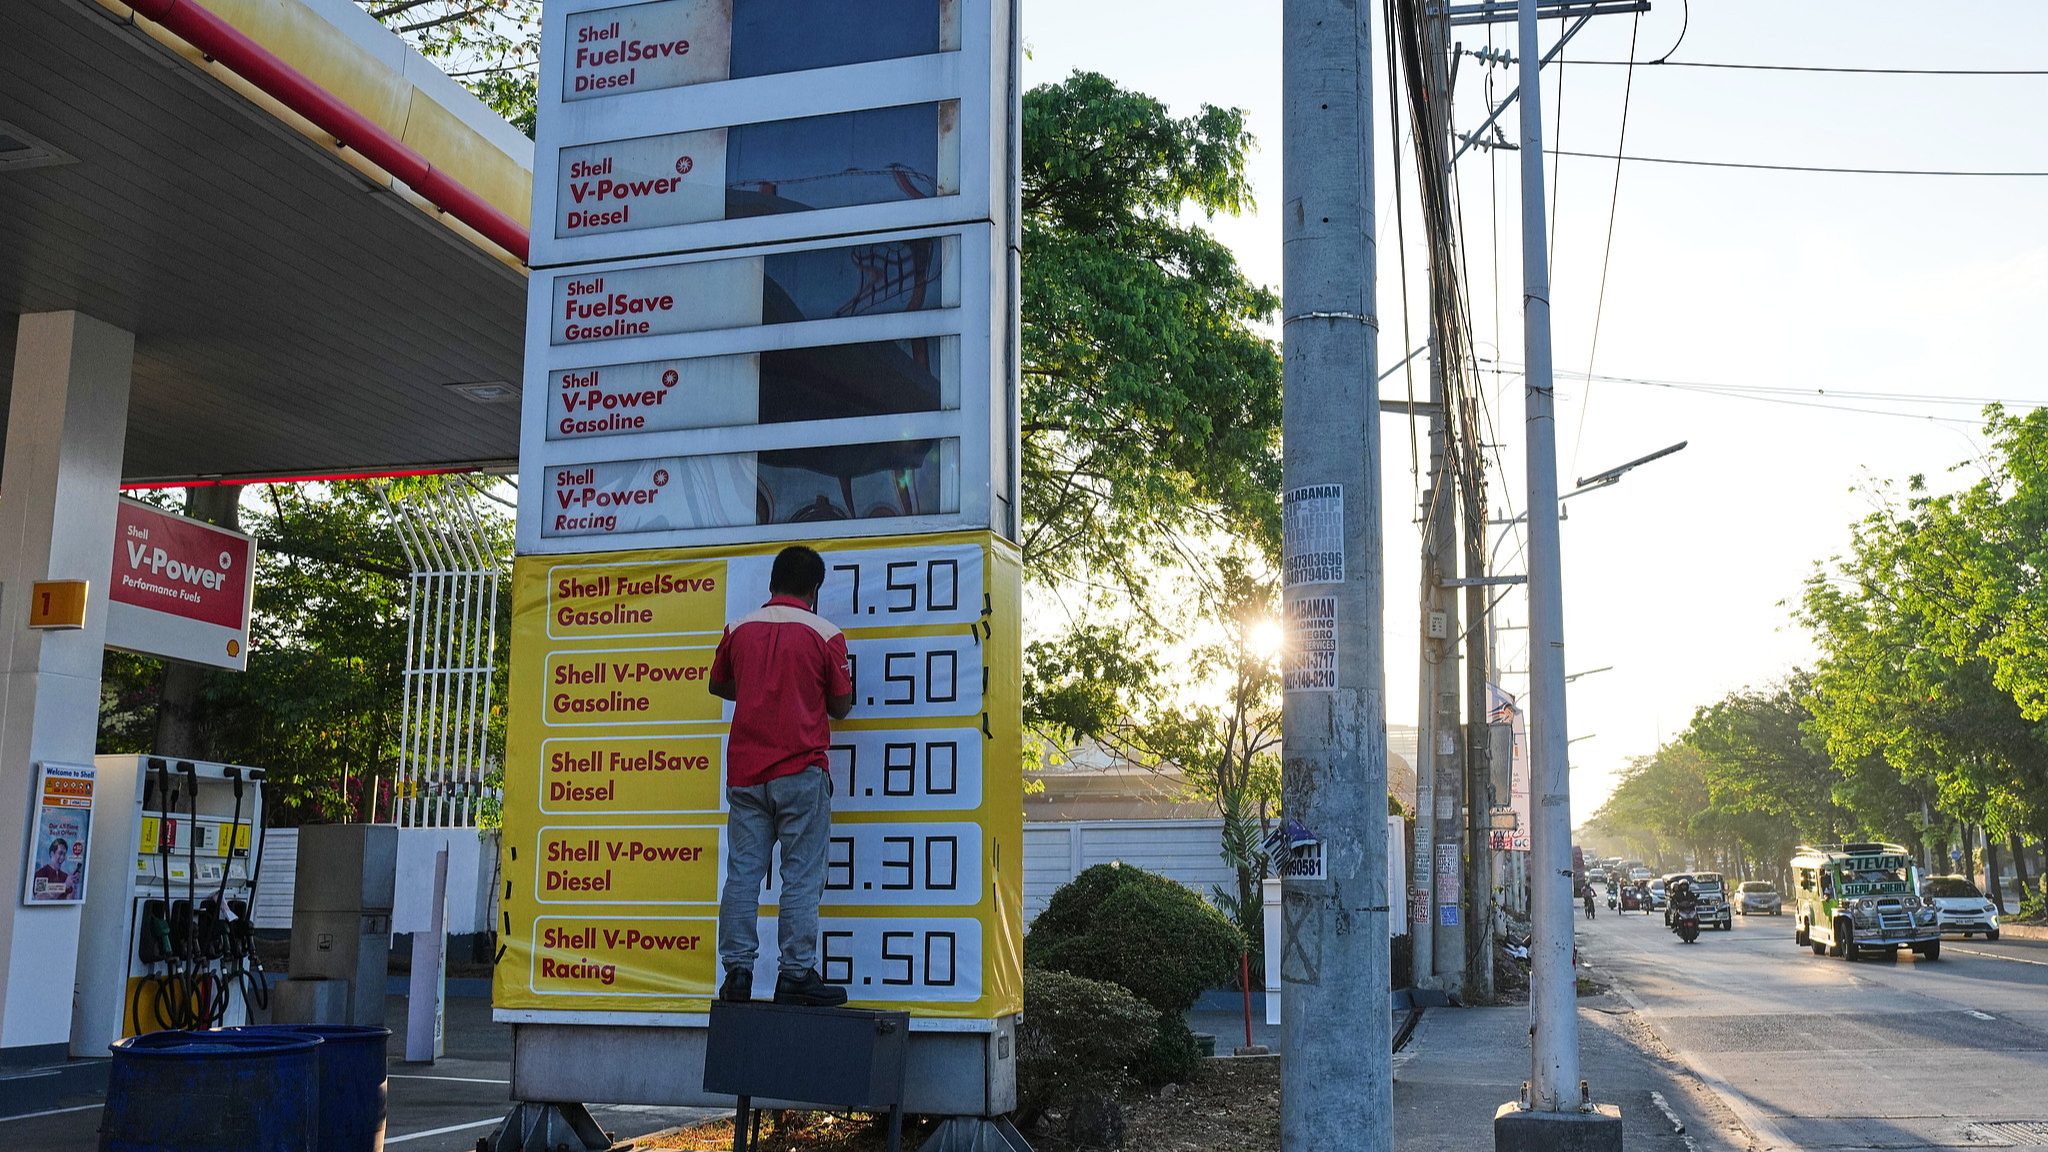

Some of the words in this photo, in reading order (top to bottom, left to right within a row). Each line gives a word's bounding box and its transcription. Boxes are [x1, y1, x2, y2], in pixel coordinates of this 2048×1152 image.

[578, 23, 620, 43] Shell
[576, 37, 690, 68] FuelSave
[574, 69, 635, 92] Diesel
[570, 157, 613, 179] Shell
[570, 174, 682, 203] V-Power
[567, 206, 629, 229] Diesel
[567, 278, 604, 296] Shell
[565, 293, 674, 319] FuelSave
[565, 320, 650, 341] Gasoline
[562, 371, 599, 389] Shell
[562, 388, 667, 413] V-Power
[560, 414, 645, 435] Gasoline
[557, 469, 594, 487] Shell
[557, 487, 659, 509] V-Power
[555, 513, 617, 532] Racing
[1302, 512, 1340, 527] NEGRO
[128, 525, 149, 540] Shell
[126, 539, 226, 591] V-Power
[122, 575, 178, 598] Performance
[179, 589, 201, 604] Fuels
[558, 576, 610, 599] Shell
[616, 574, 715, 596] FuelSave
[41, 592, 51, 616] 1
[557, 603, 653, 627] Gasoline
[1302, 630, 1333, 640] NEGRO
[1305, 640, 1335, 651] SERVICES
[554, 663, 606, 685] Shell
[613, 663, 709, 683] V-Power
[553, 691, 650, 713] Gasoline
[551, 751, 603, 773] Shell
[609, 750, 710, 772] FuelSave
[46, 767, 73, 777] Welcome
[80, 770, 95, 779] Shell
[550, 779, 615, 801] Diesel
[547, 840, 599, 862] Shell
[605, 841, 703, 862] V-Power
[1845, 856, 1904, 870] STEVEN
[546, 869, 612, 891] Diesel
[543, 927, 597, 949] Shell
[602, 929, 701, 950] V-Power
[542, 957, 616, 985] Racing
